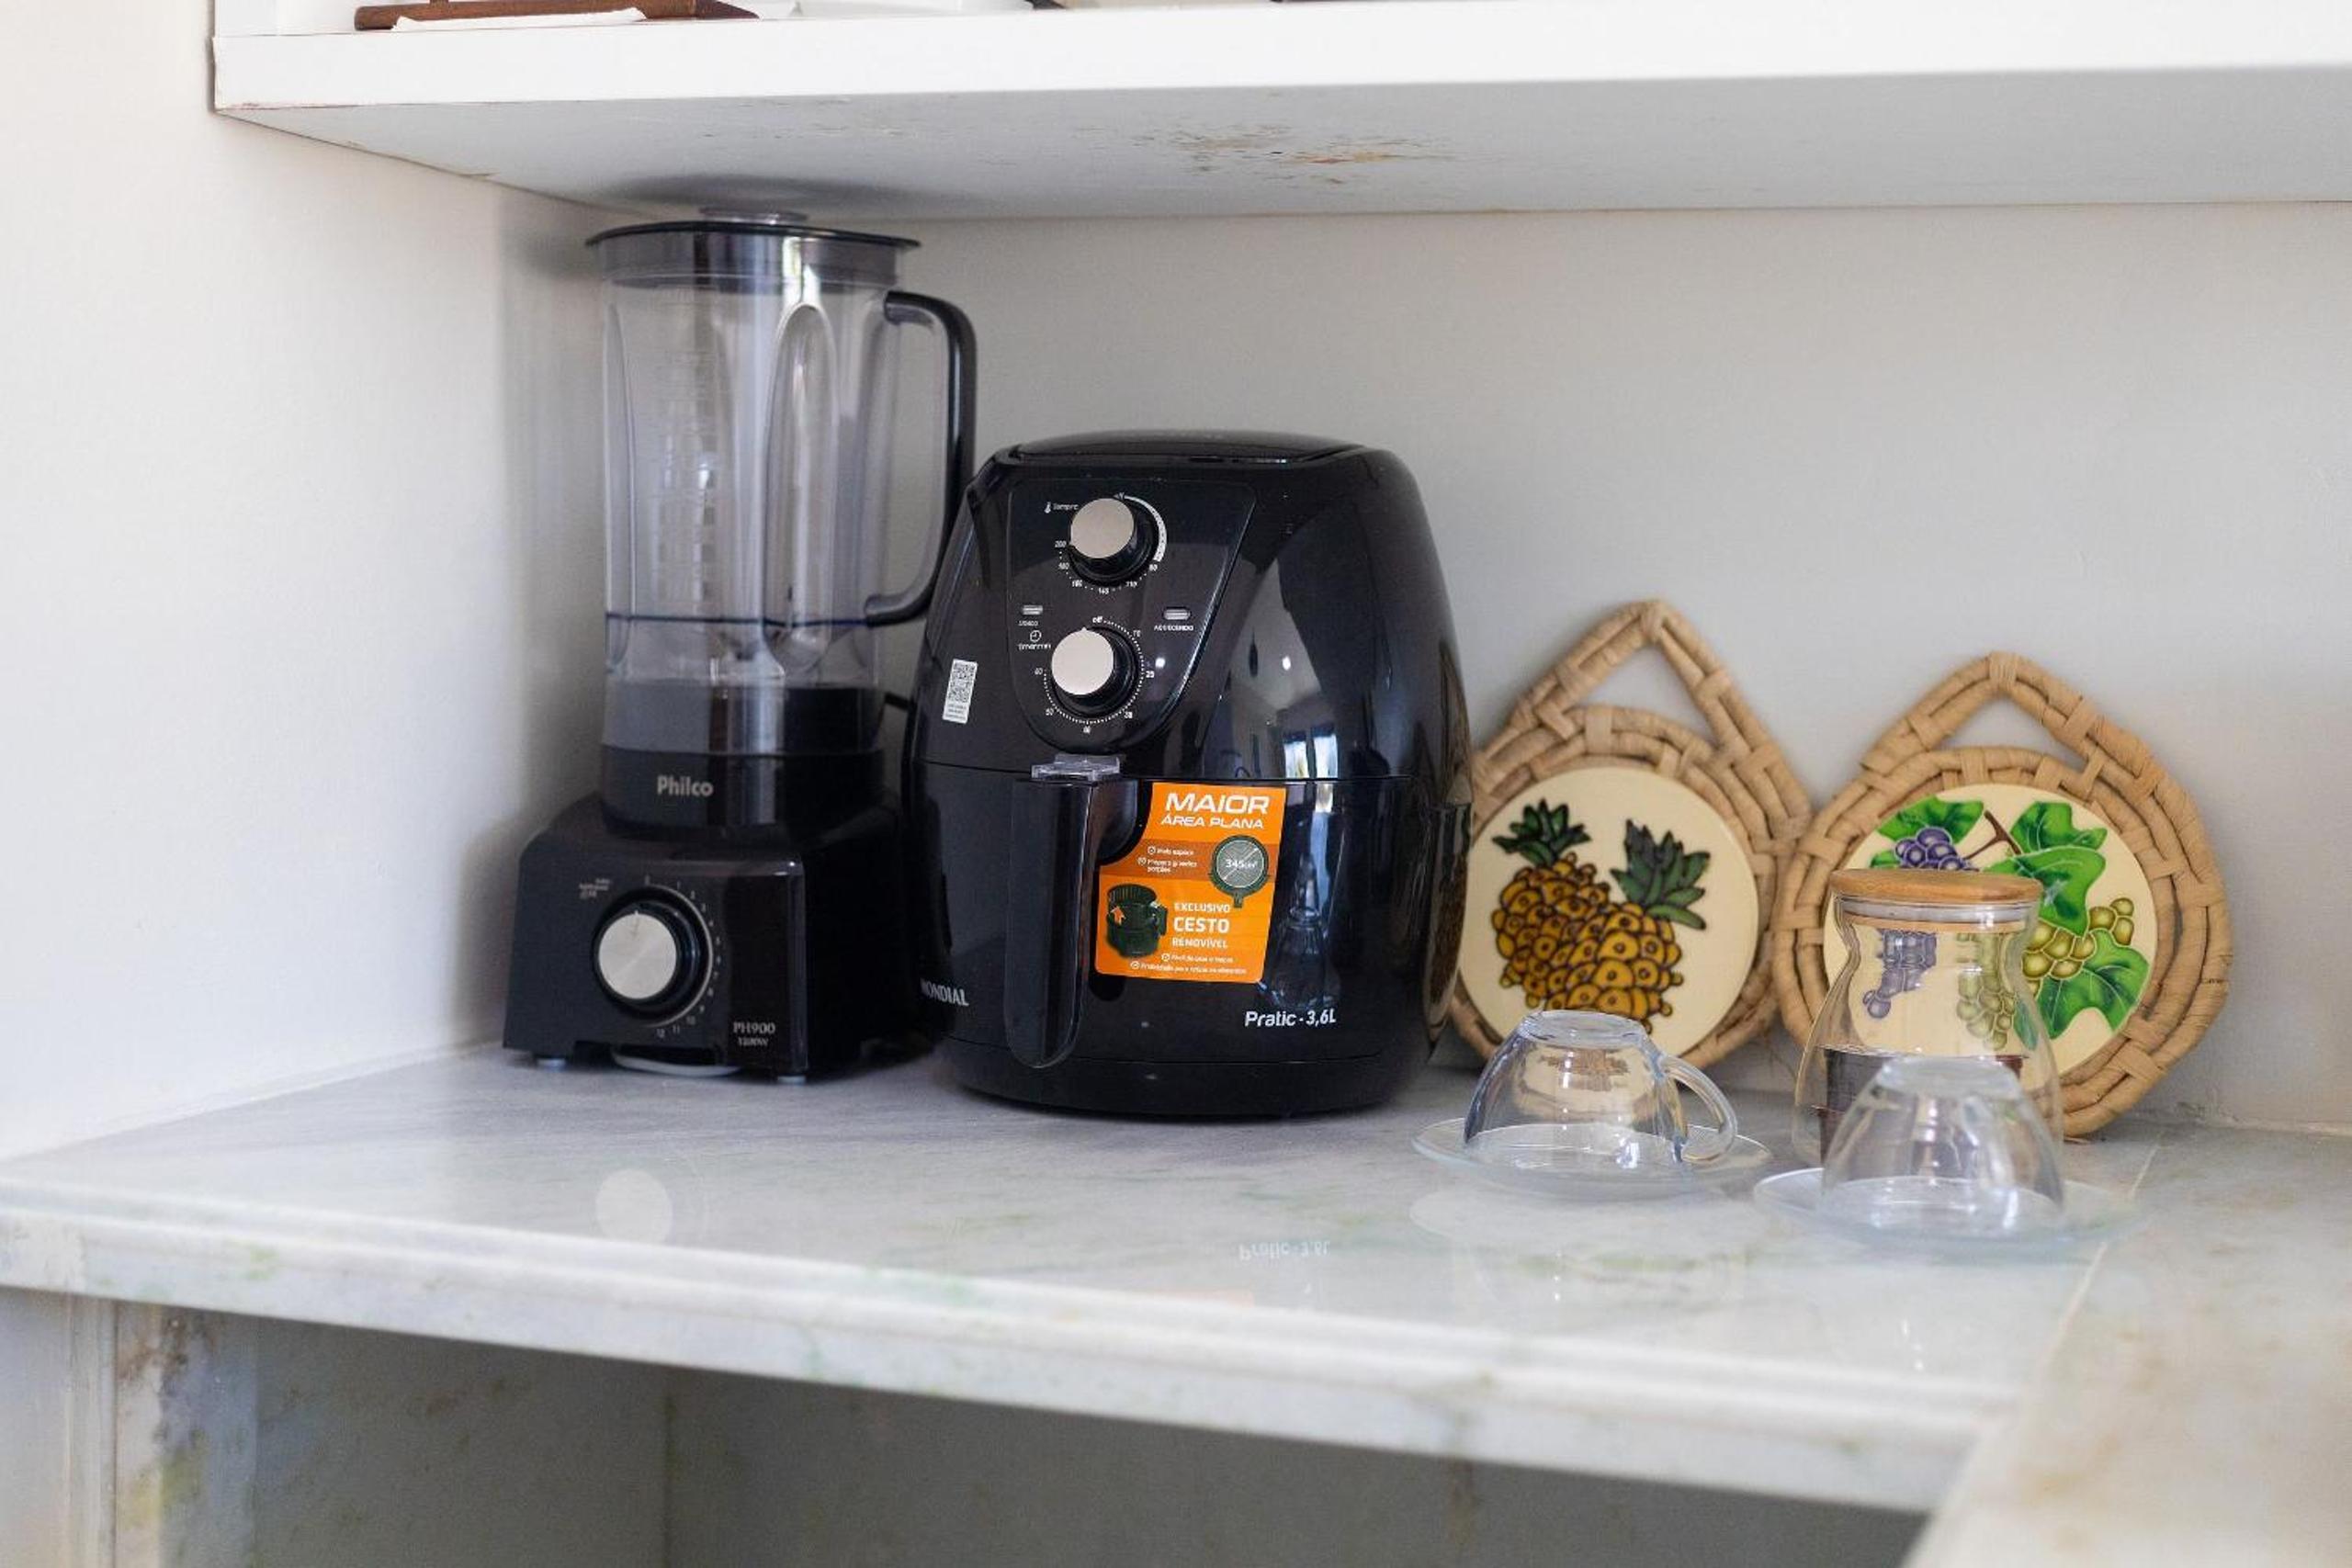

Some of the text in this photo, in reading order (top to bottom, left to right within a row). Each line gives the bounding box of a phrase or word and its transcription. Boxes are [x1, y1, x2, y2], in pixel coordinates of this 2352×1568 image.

[656, 774, 714, 798] Philco
[1165, 793, 1270, 815] MAIOR
[1160, 812, 1264, 829] ÁREA PLANA
[1173, 902, 1231, 914] EXCLUSIVO
[1173, 917, 1230, 933] CESTO
[1244, 1010, 1297, 1027] Pratic
[1306, 1009, 1337, 1027] 3,6L
[732, 1021, 776, 1034] PH900
